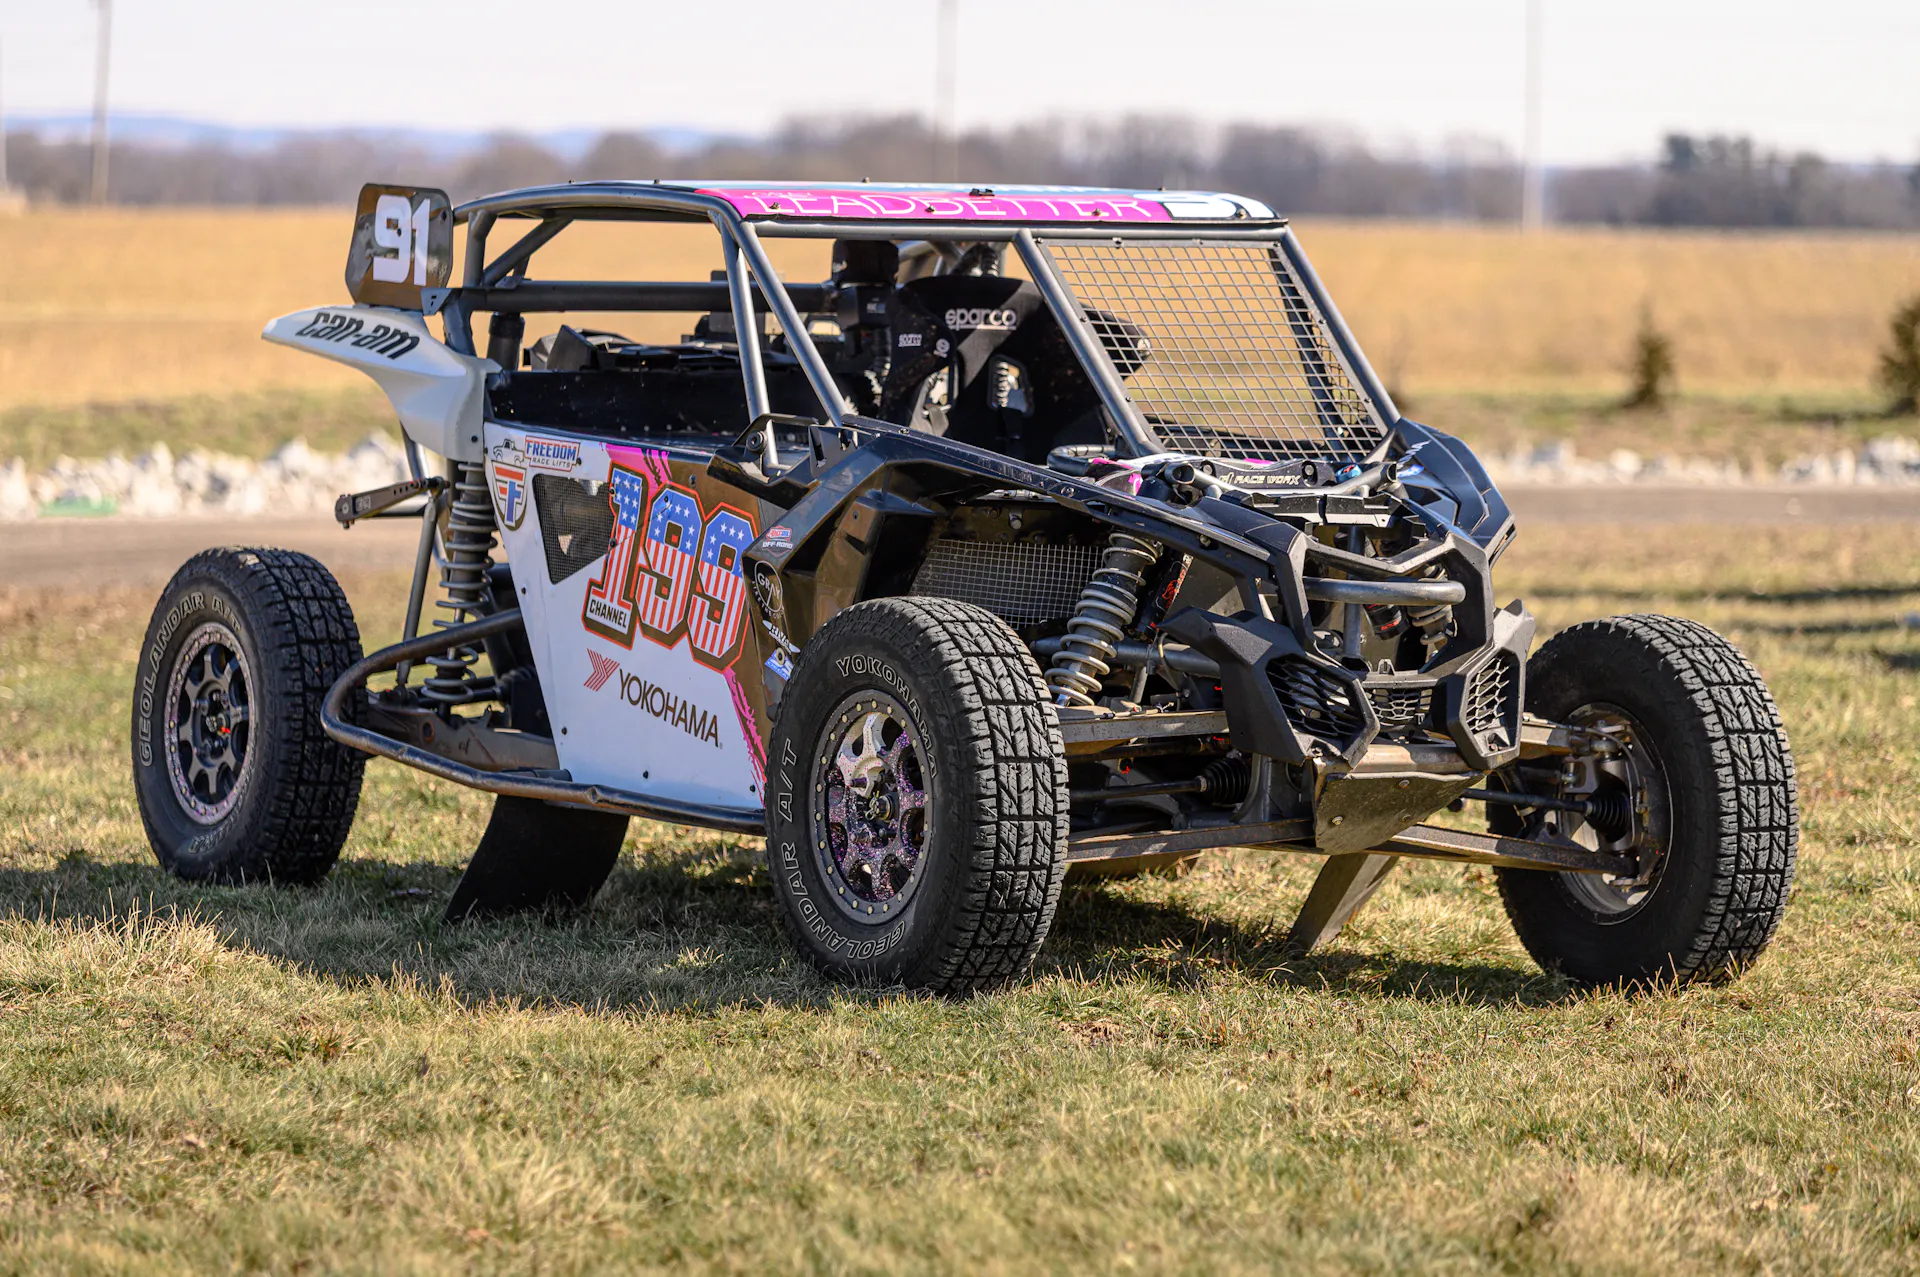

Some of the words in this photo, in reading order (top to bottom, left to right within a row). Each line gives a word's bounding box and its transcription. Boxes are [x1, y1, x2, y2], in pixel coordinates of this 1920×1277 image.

[744, 194, 1152, 218] LEADBETTER
[373, 194, 430, 287] 91
[295, 312, 420, 361] can-am
[945, 309, 1017, 331] sparco
[525, 439, 577, 461] FREEDOM
[532, 457, 550, 465] RACE
[552, 460, 571, 468] LIFTS
[1234, 475, 1265, 484] RACE
[1266, 475, 1301, 485] WORX
[587, 466, 750, 661] 199
[762, 541, 793, 549] OFF-ROAD
[589, 599, 628, 628] CHANNEL
[139, 591, 205, 767] GEOLANDAR
[619, 668, 719, 747] YOKOHAMA
[836, 654, 938, 779] YOKOHAMA
[777, 738, 797, 823] A/T
[780, 842, 905, 960] GEOLANDAR
